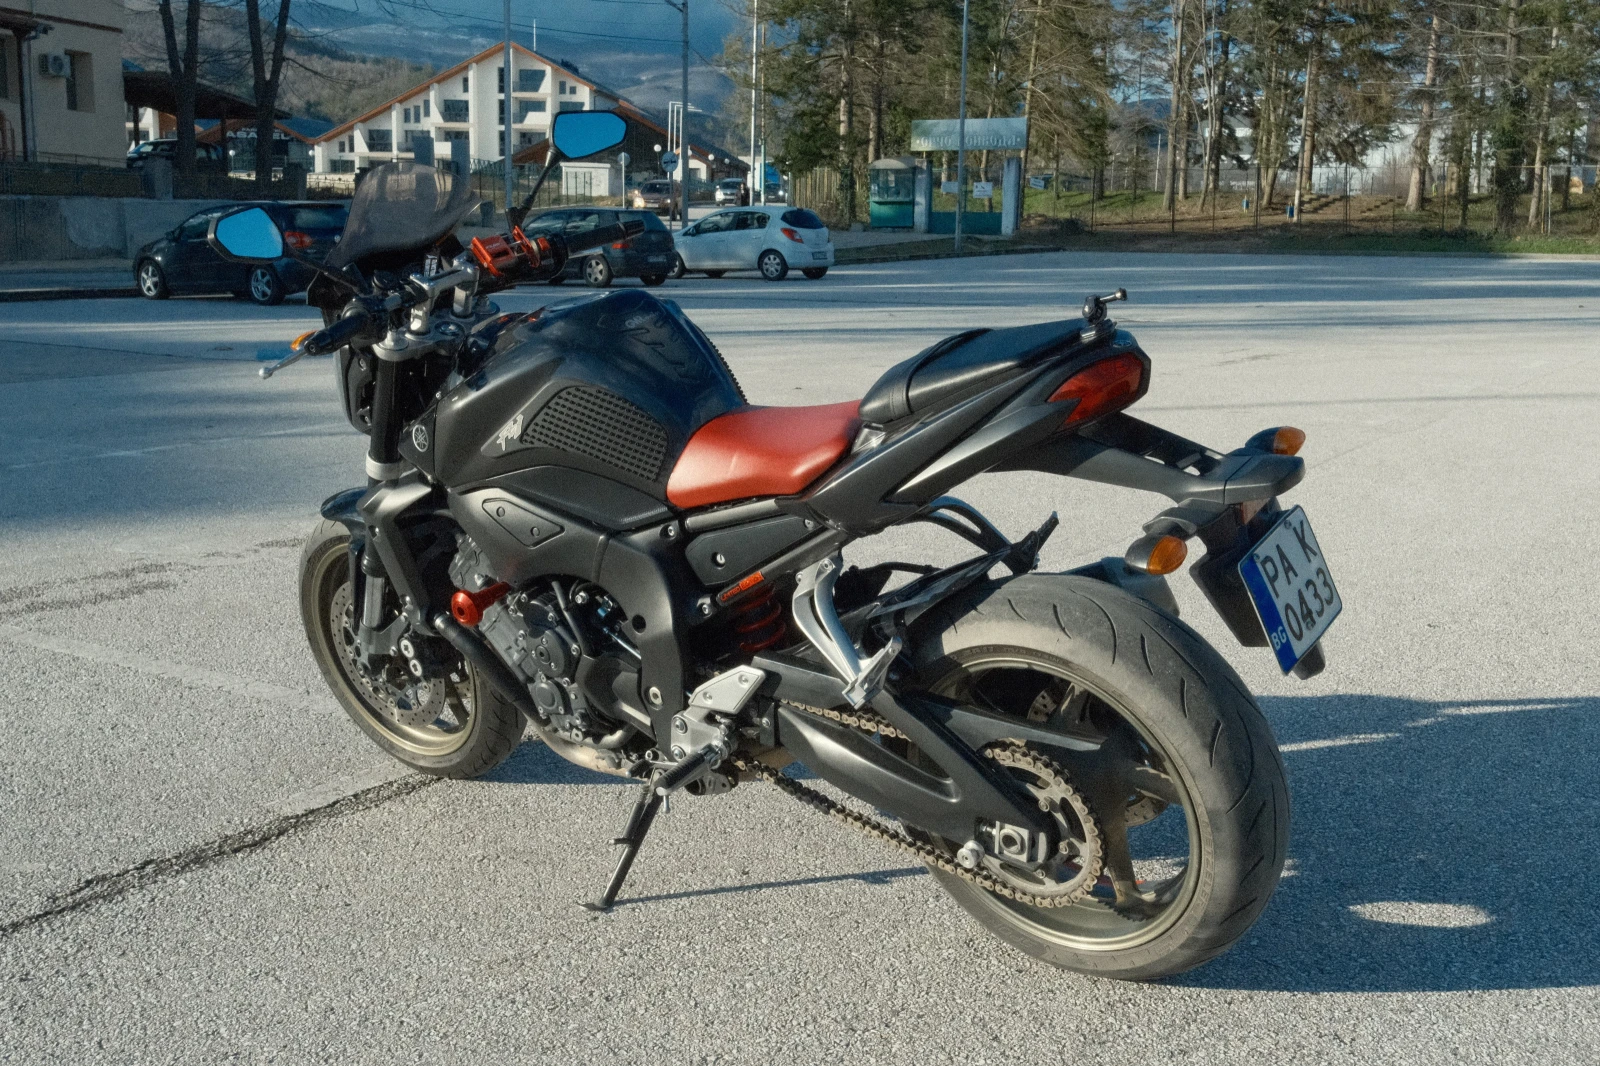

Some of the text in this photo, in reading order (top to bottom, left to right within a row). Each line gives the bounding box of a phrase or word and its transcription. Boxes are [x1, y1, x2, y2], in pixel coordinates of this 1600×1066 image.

[226, 131, 289, 140] ASAEL
[1260, 519, 1318, 599] PA K
[1284, 566, 1335, 643] 0433
[1271, 625, 1288, 651] BG
